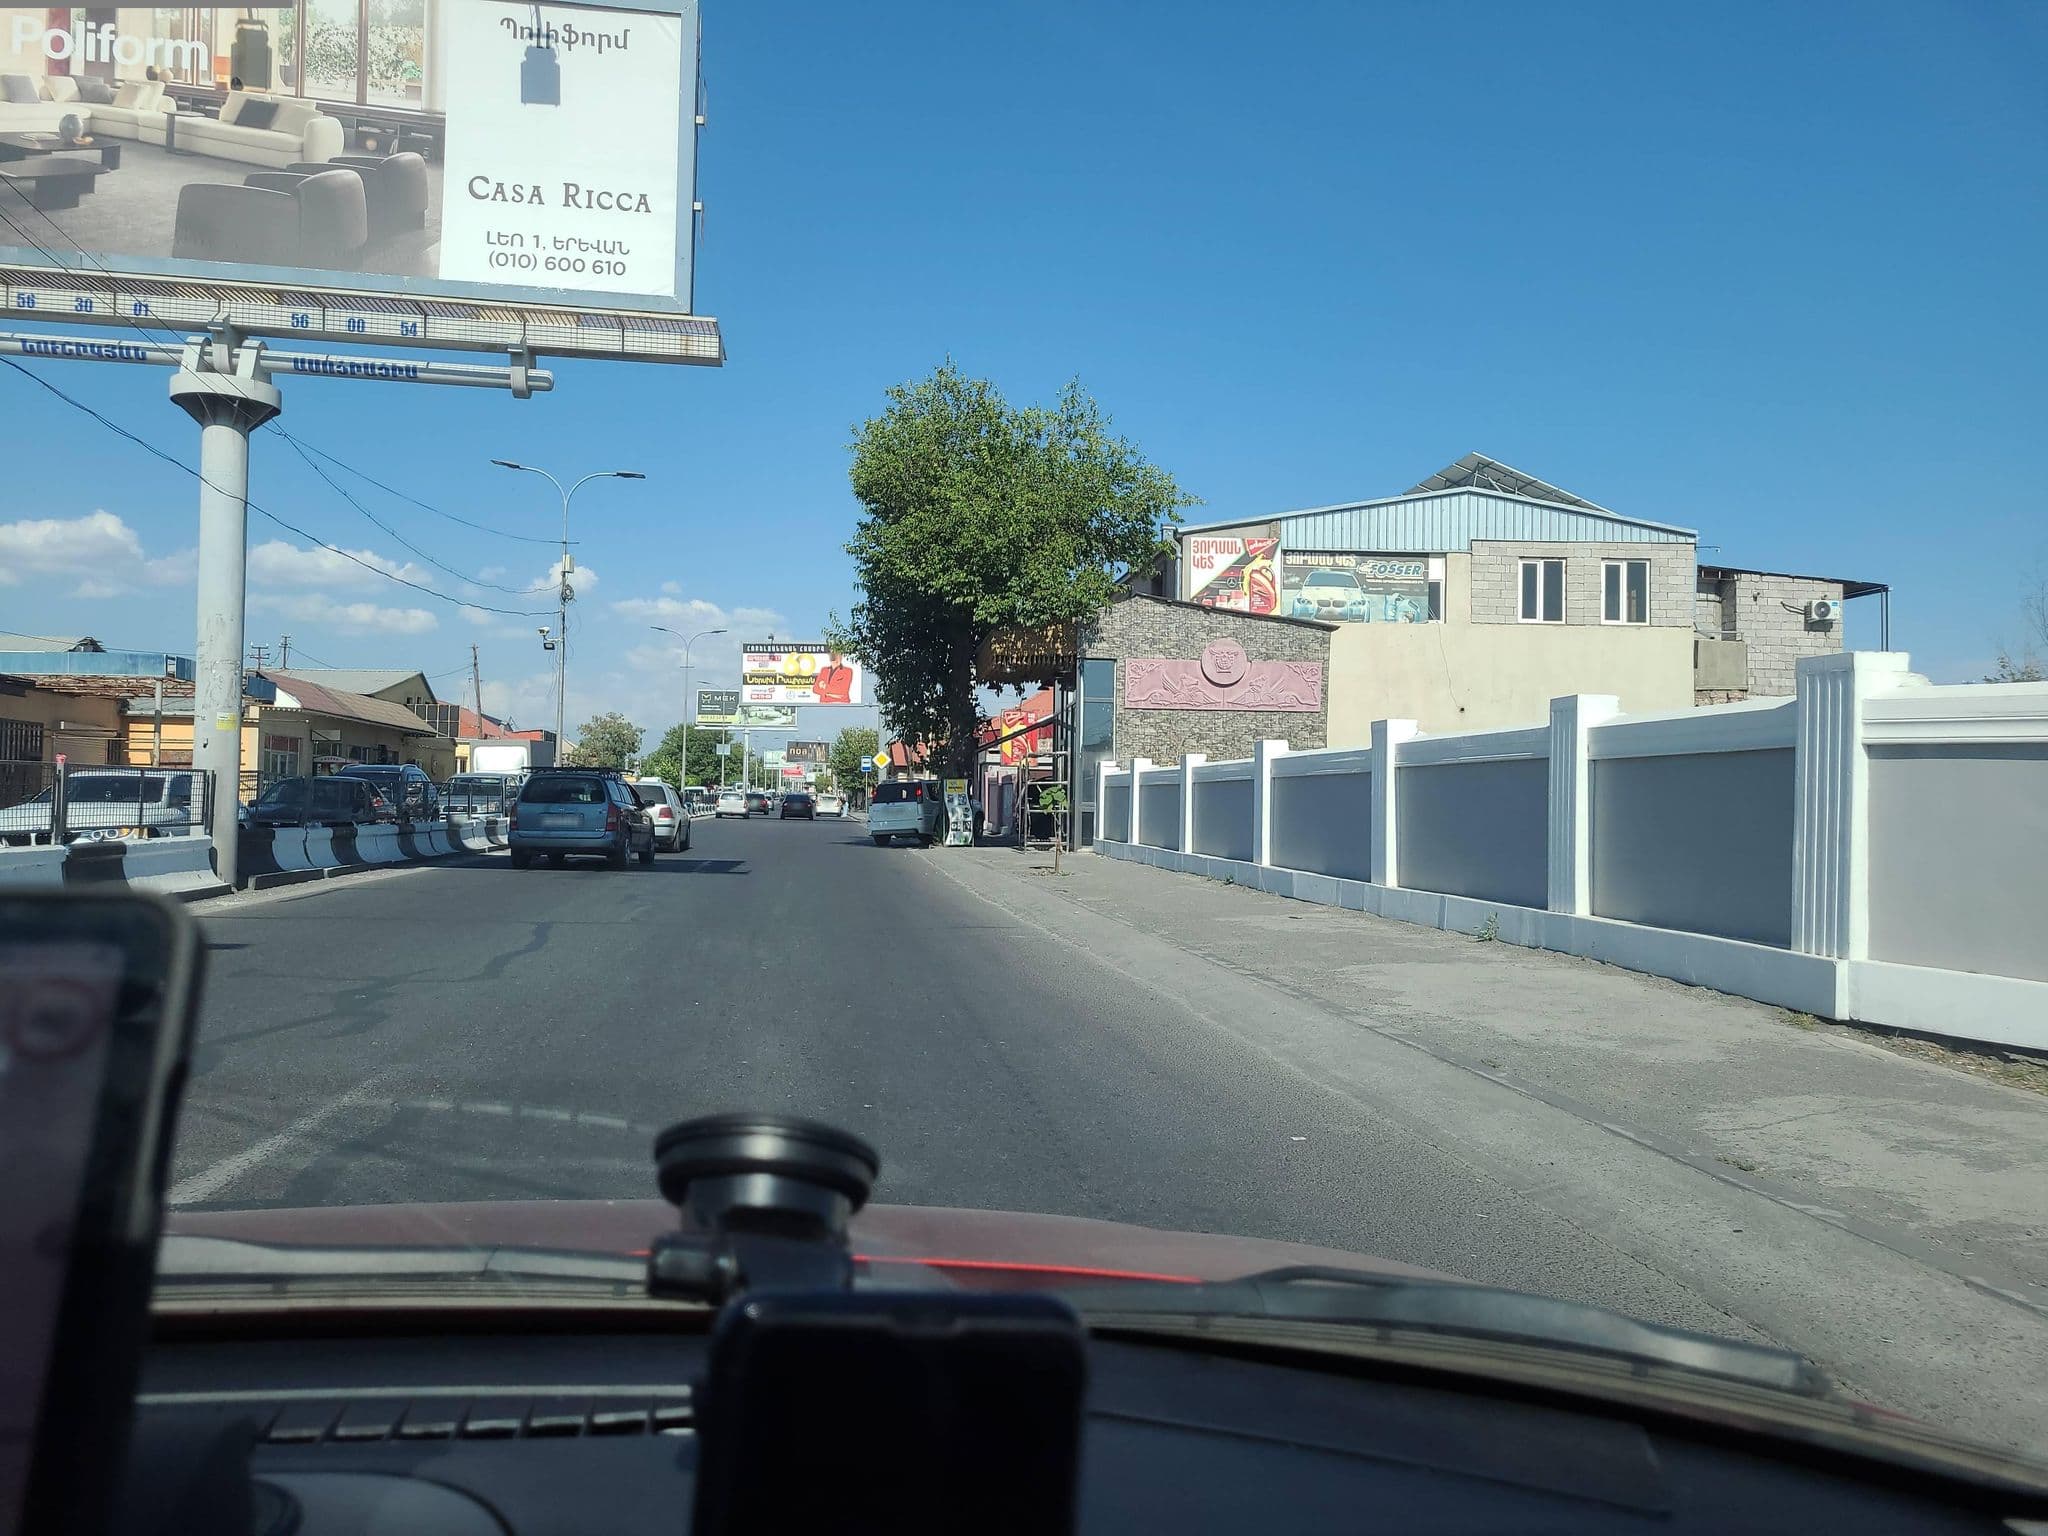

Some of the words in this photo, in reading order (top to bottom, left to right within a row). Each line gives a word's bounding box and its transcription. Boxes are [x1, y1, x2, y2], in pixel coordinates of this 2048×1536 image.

[11, 15, 208, 71] Poliform
[500, 17, 630, 54] Պոլիֆորմ
[533, 235, 546, 250] 1,
[553, 236, 630, 255] ԵՐԵՎԱՆ
[489, 250, 537, 271] (010)
[545, 256, 586, 273] 600
[592, 260, 626, 276] 610
[17, 293, 36, 308] 56
[75, 297, 93, 313] 30
[133, 302, 149, 316] 01
[291, 313, 309, 329] 56
[347, 317, 365, 333] 00
[400, 321, 417, 337] 54
[1192, 556, 1215, 568] ԿԵՏ
[1369, 564, 1422, 575] FOSSER
[783, 652, 816, 677] 60
